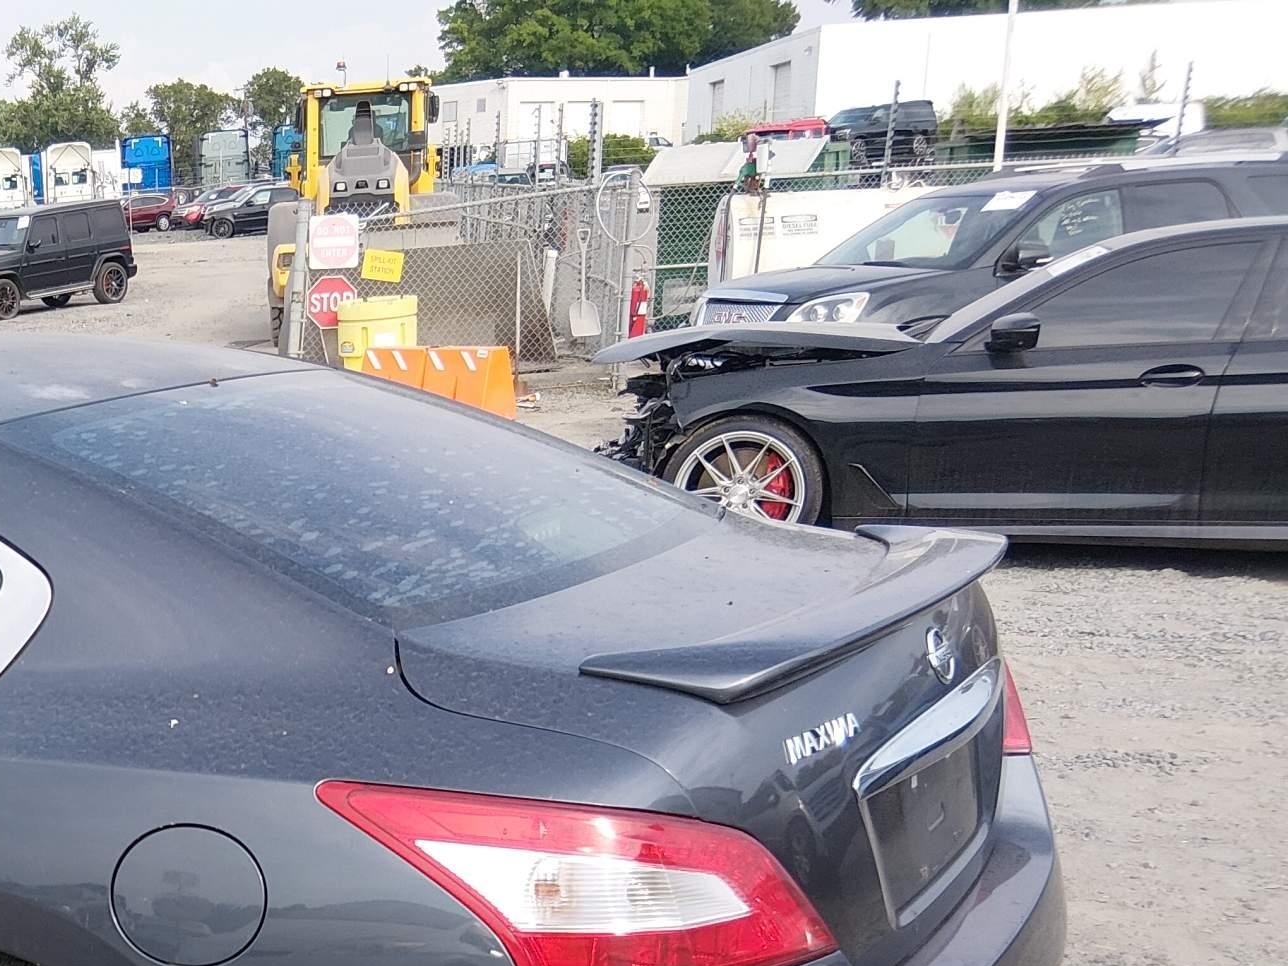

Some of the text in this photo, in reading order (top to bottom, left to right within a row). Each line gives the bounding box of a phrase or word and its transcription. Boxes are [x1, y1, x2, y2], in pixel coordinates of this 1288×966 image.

[317, 225, 351, 236] DO NOT
[320, 247, 349, 257] ENTER
[782, 712, 861, 765] MAXIMA
